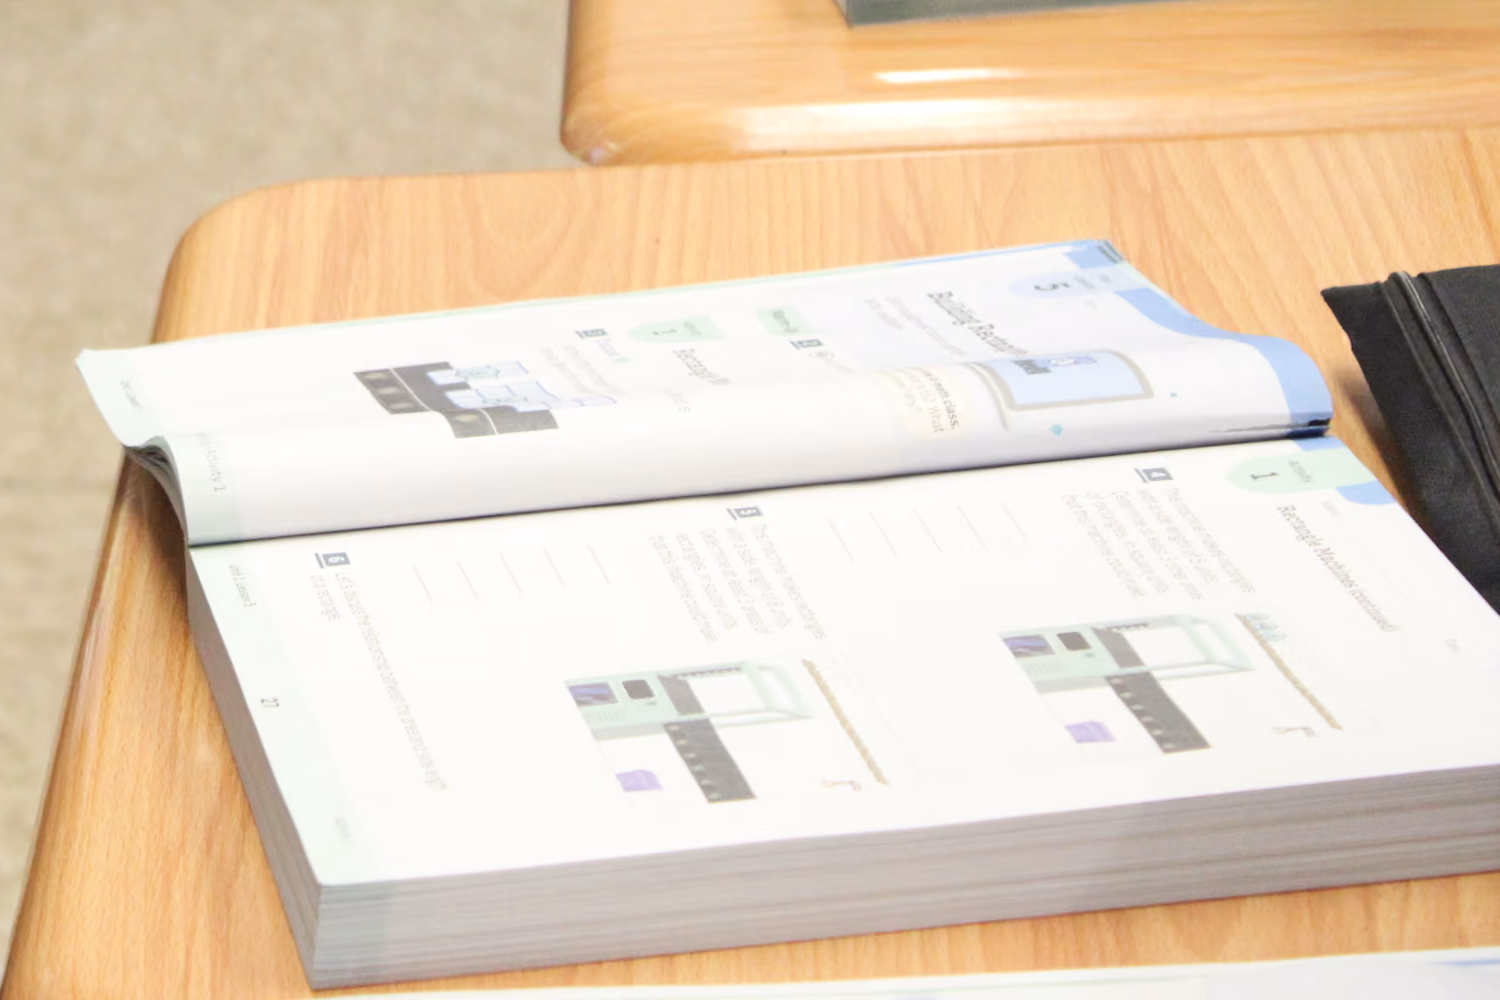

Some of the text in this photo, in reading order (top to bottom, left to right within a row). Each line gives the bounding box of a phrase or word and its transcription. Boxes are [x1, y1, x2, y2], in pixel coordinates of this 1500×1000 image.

[926, 291, 982, 326] Building
[1217, 558, 1256, 593] rectangles
[1276, 504, 1399, 632] Rectangle Machines (continued)
[343, 589, 366, 615] discuss
[795, 601, 827, 640] rectangles
[260, 697, 280, 707] 27
